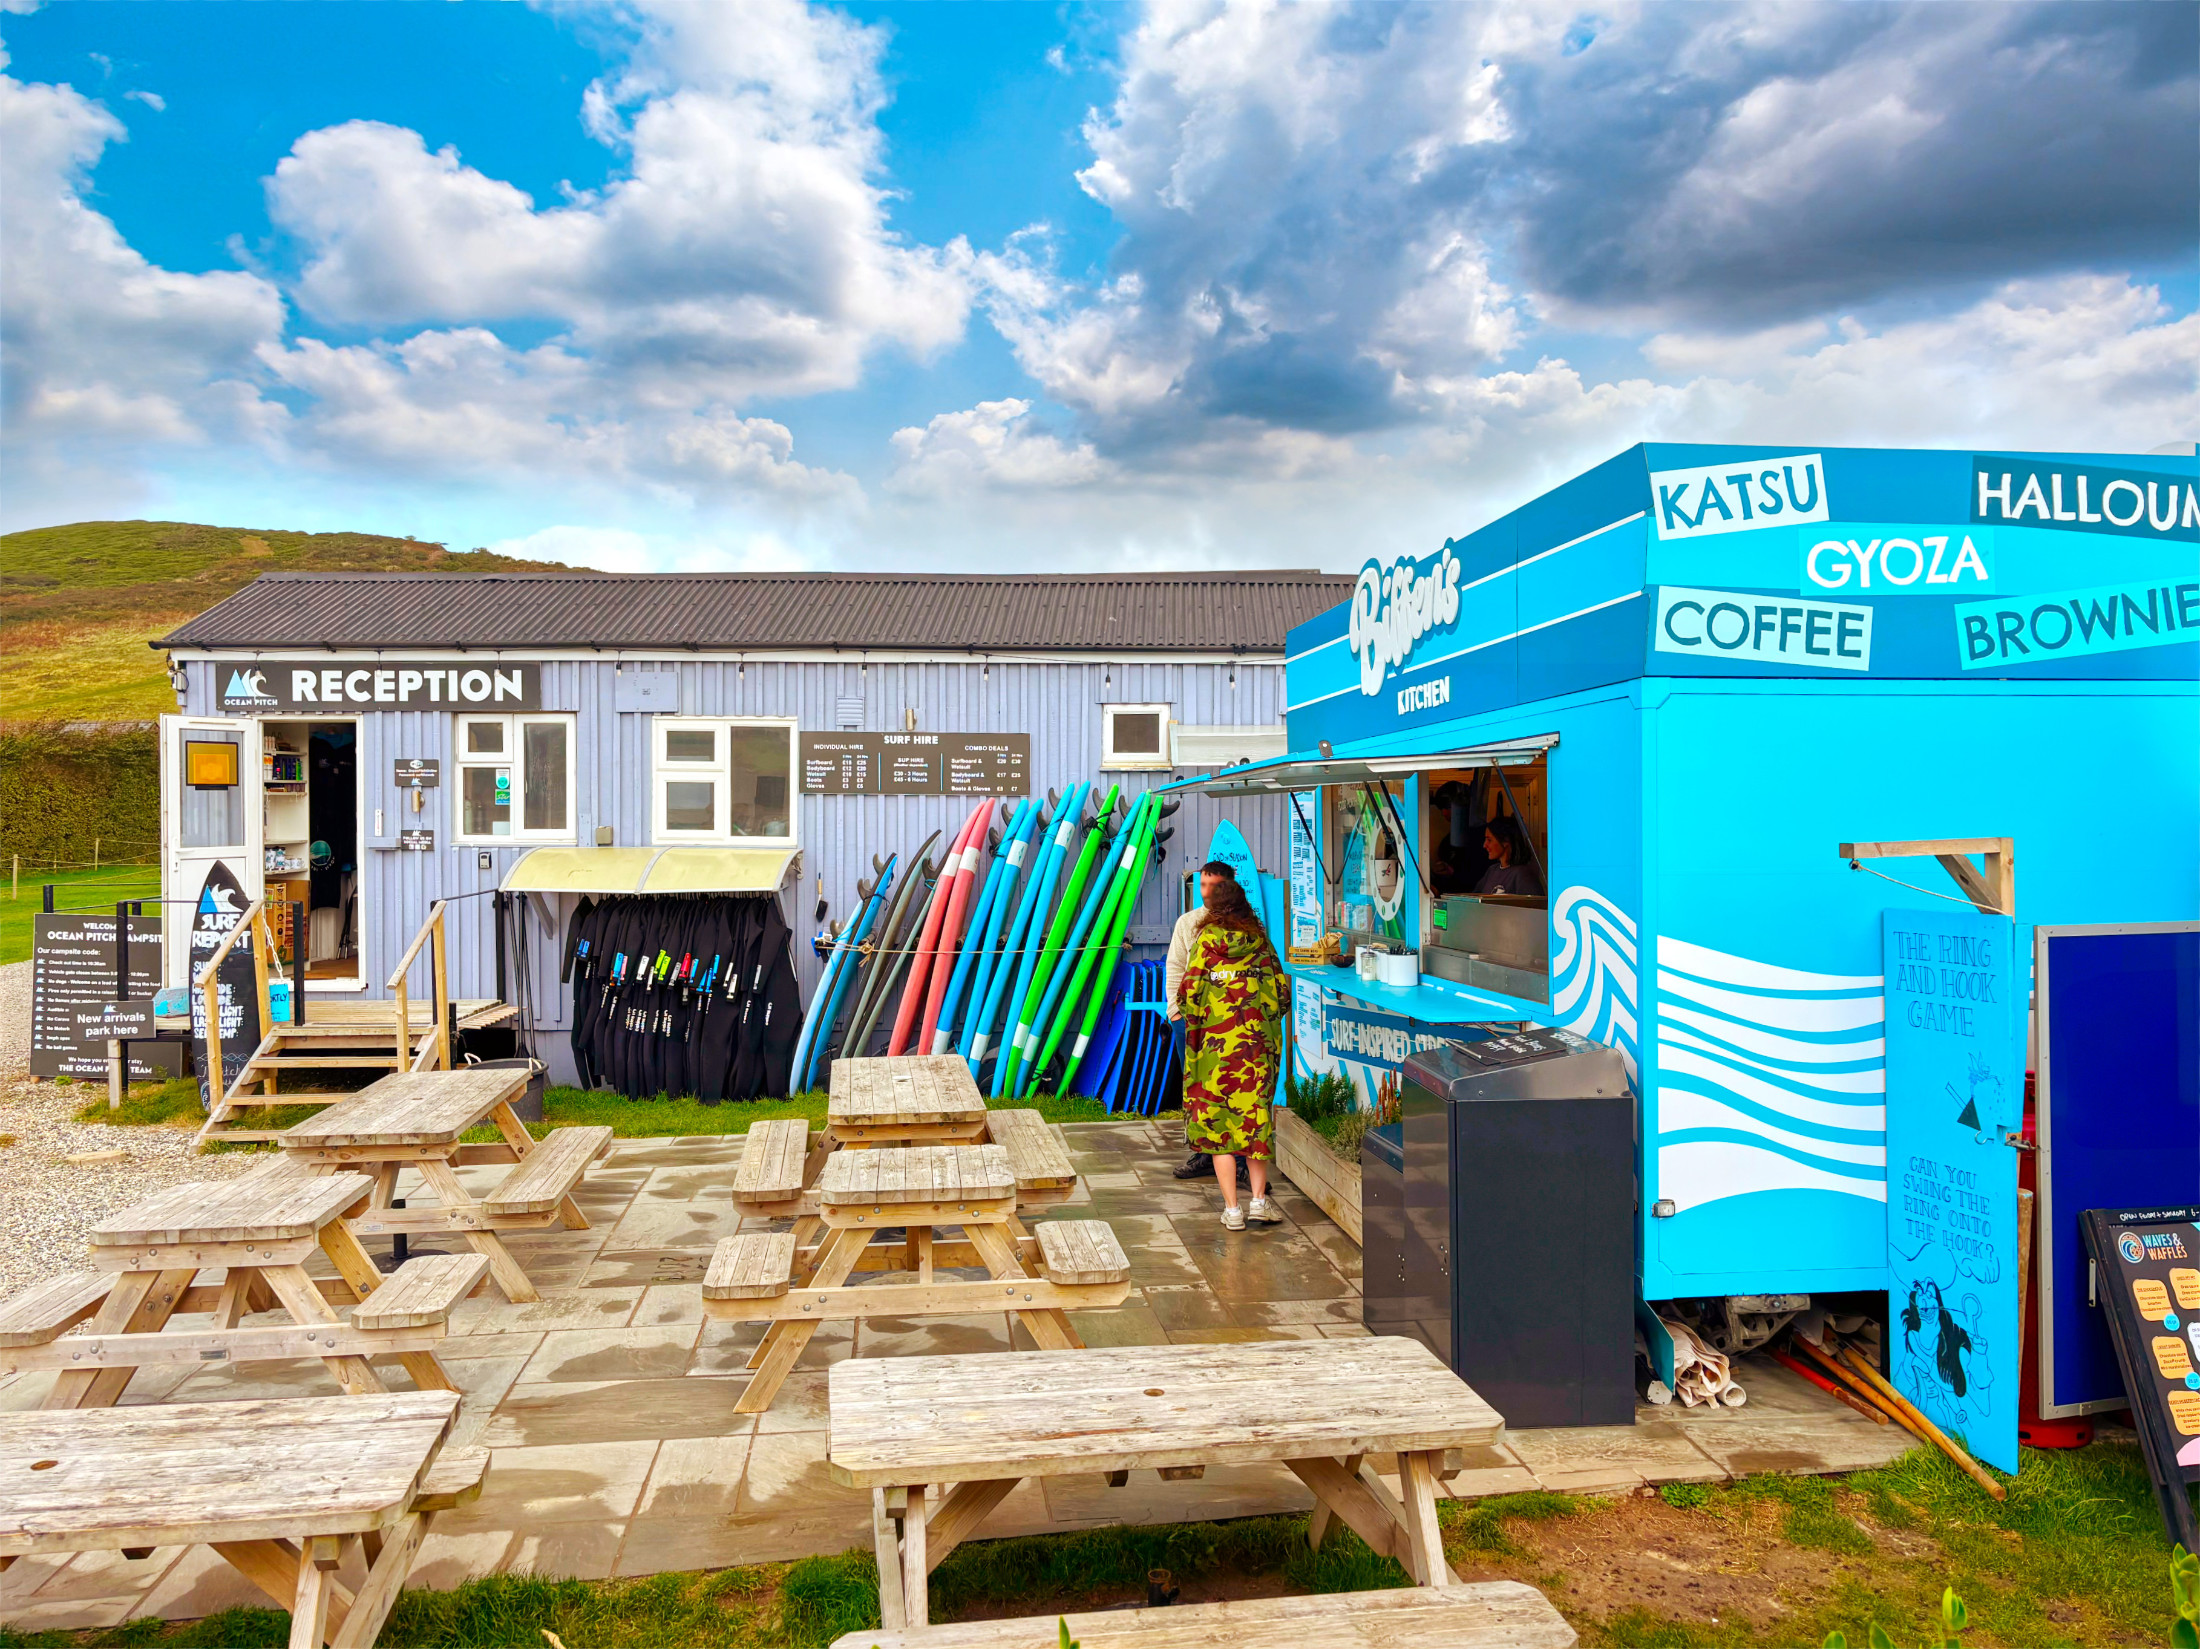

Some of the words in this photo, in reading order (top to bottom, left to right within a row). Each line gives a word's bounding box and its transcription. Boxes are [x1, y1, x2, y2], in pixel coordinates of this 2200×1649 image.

[1659, 463, 1819, 529] KATSU
[1806, 535, 1988, 588] GYOZA
[1350, 547, 1461, 697] Biffen's
[1664, 600, 1863, 659] COFFEE
[1963, 583, 2200, 662] BROWNIE
[291, 669, 522, 702] RECEPTION
[1397, 675, 1450, 715] KITCHEN
[884, 735, 911, 745] SURF
[913, 735, 939, 745] HIRE
[48, 931, 83, 940] OCEAN
[87, 932, 117, 942] PITCH
[83, 922, 117, 930] WELCOM
[201, 913, 240, 930] SURF
[1893, 931, 1931, 961] THE
[1938, 934, 1991, 968] RING
[1896, 964, 1936, 995] AND
[1940, 968, 1998, 1003] HOOK
[77, 1013, 101, 1023] New
[104, 1012, 146, 1022] arrivals
[85, 1026, 111, 1037] park
[113, 1025, 138, 1034] here
[1907, 1000, 1975, 1037] GAME
[1331, 1017, 1411, 1063] SURF-INSPIRED
[130, 1066, 152, 1074] TEAM
[1909, 1156, 1939, 1179] CAN
[1944, 1165, 1977, 1190] YOU
[1903, 1173, 1952, 1203] SWING
[1955, 1189, 1990, 1215] THE
[1904, 1194, 1940, 1221] RING
[1948, 1209, 1991, 1237] ONTO
[2119, 1212, 2138, 1222] OPEN
[1905, 1218, 1935, 1243] THE
[1942, 1229, 1994, 1262] HOOK?
[2142, 1233, 2172, 1247] WAVES
[2172, 1232, 2182, 1246] &
[2147, 1246, 2188, 1261] WAFFLES
